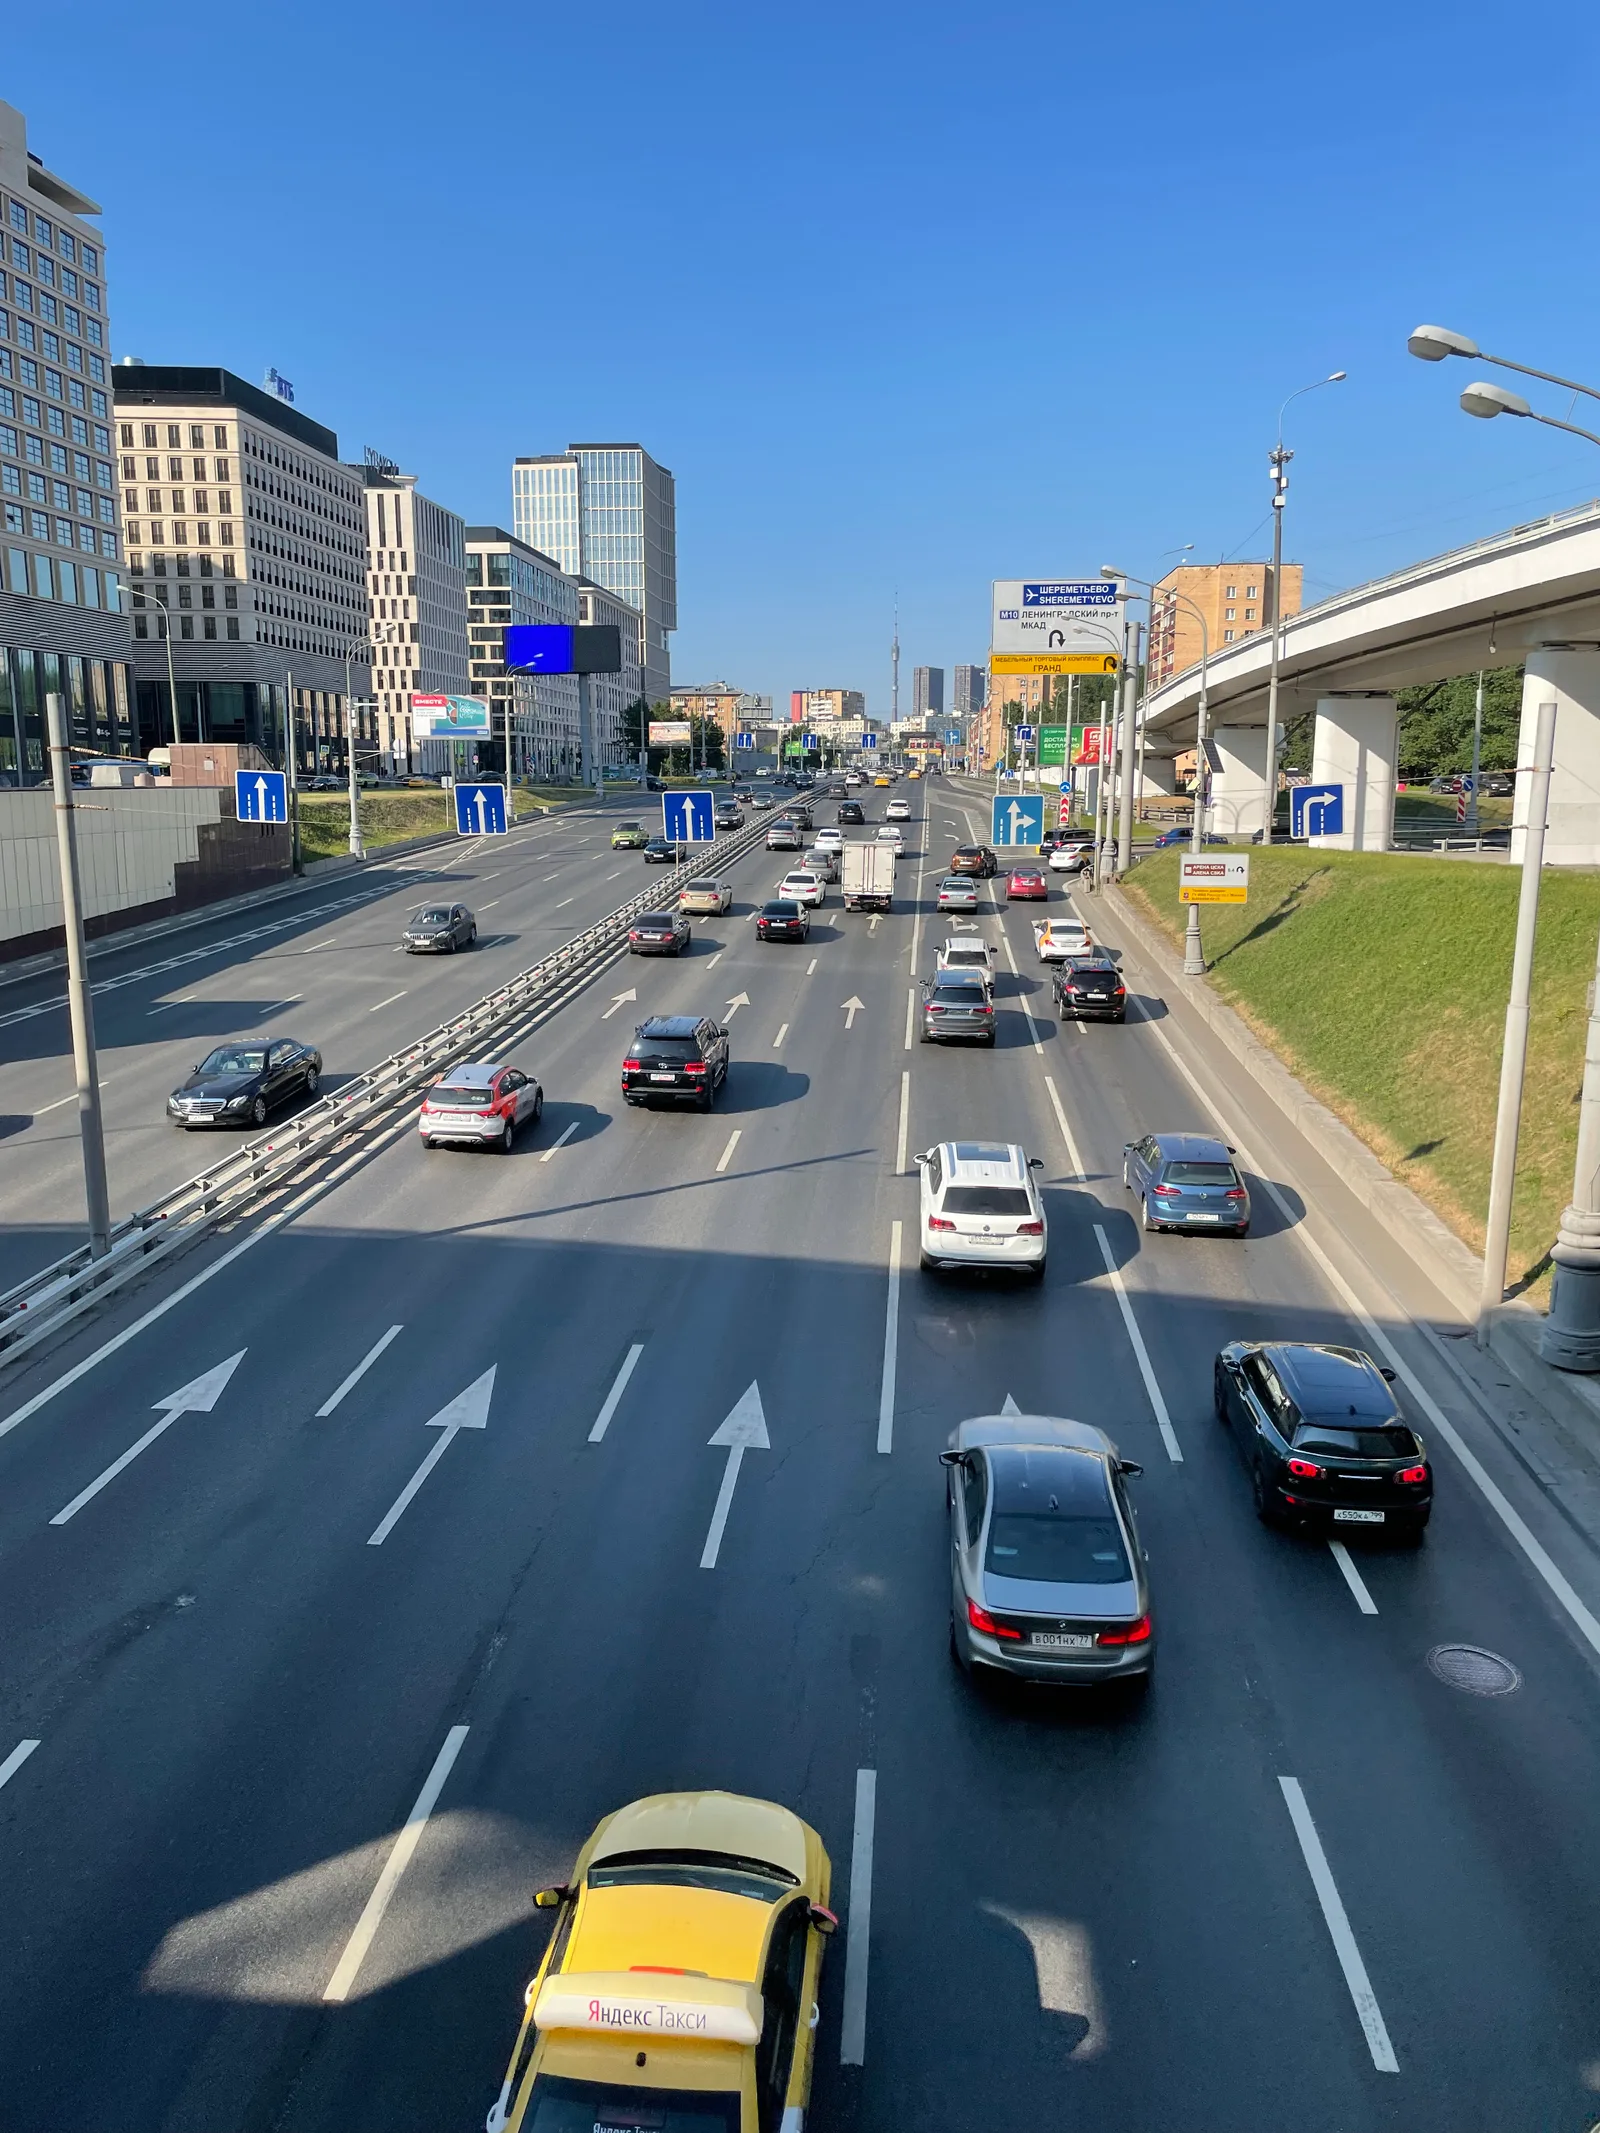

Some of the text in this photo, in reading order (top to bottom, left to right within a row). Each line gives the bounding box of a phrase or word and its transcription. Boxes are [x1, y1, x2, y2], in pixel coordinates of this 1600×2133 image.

[1039, 585, 1109, 594] ШЕРЕМЕТЬЕВО
[1039, 595, 1114, 604] SHEREMET'YEVO
[1021, 609, 1099, 619] ЛЕНИНГРДСКИЙ
[1101, 611, 1119, 620] пр-т
[1021, 622, 1047, 630] МКАД
[1033, 664, 1062, 673] ГРАНД
[1035, 1634, 1089, 1646] В001НХ 77
[588, 1999, 707, 2030] Яндекс Такси
